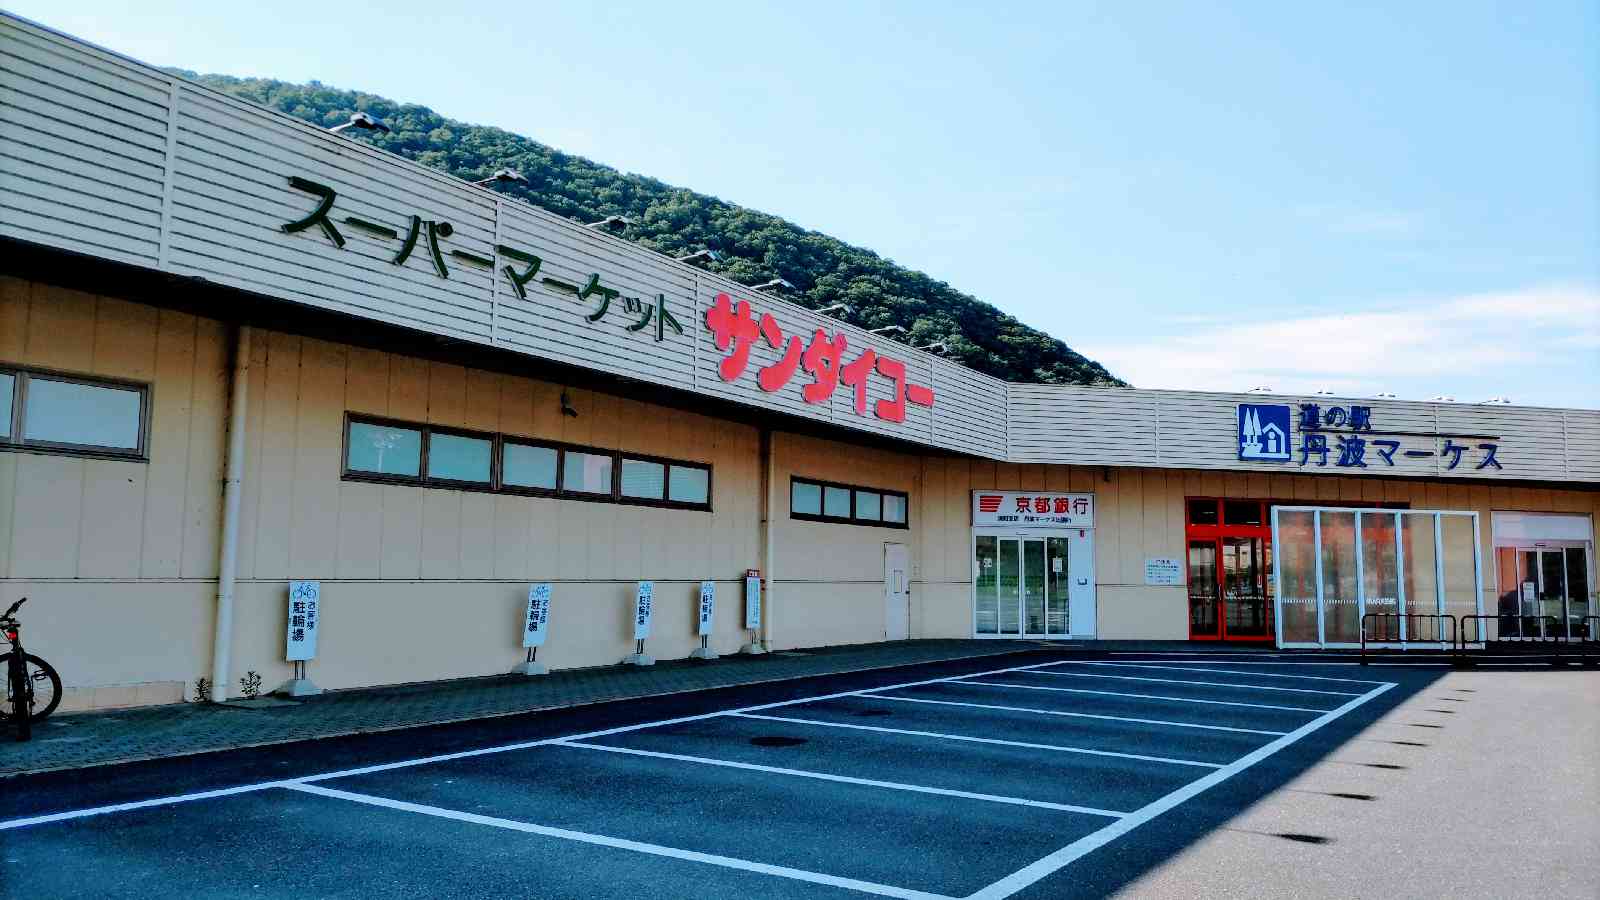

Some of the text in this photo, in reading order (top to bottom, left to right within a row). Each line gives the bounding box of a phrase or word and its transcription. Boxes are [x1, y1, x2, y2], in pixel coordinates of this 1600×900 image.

[281, 175, 934, 424] スーパーマーケット サンダイコー
[1299, 403, 1372, 431] 道の駅
[1298, 434, 1503, 471] 丹波マーケス
[1015, 496, 1089, 515] 京都銀行
[291, 601, 306, 642] 駐輪場
